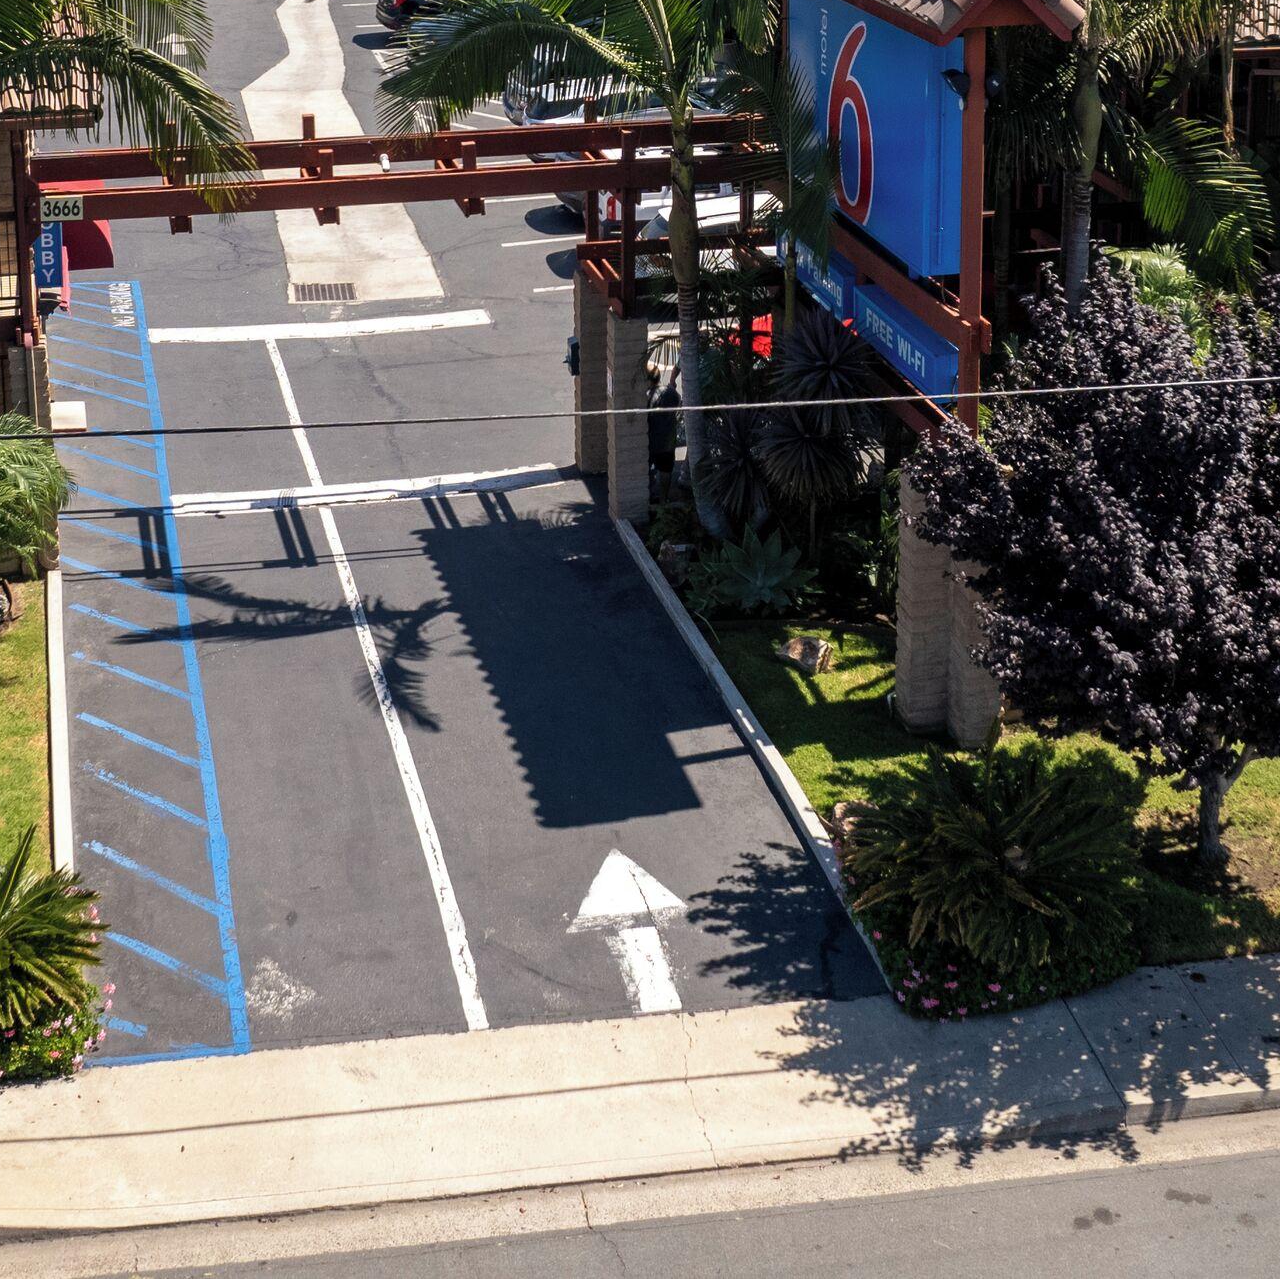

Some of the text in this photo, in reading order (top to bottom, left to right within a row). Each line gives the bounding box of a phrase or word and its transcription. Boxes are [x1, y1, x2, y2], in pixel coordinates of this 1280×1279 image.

[819, 7, 875, 227] motel 6
[43, 200, 81, 218] 3666
[865, 307, 926, 378] FREE WI-FI
